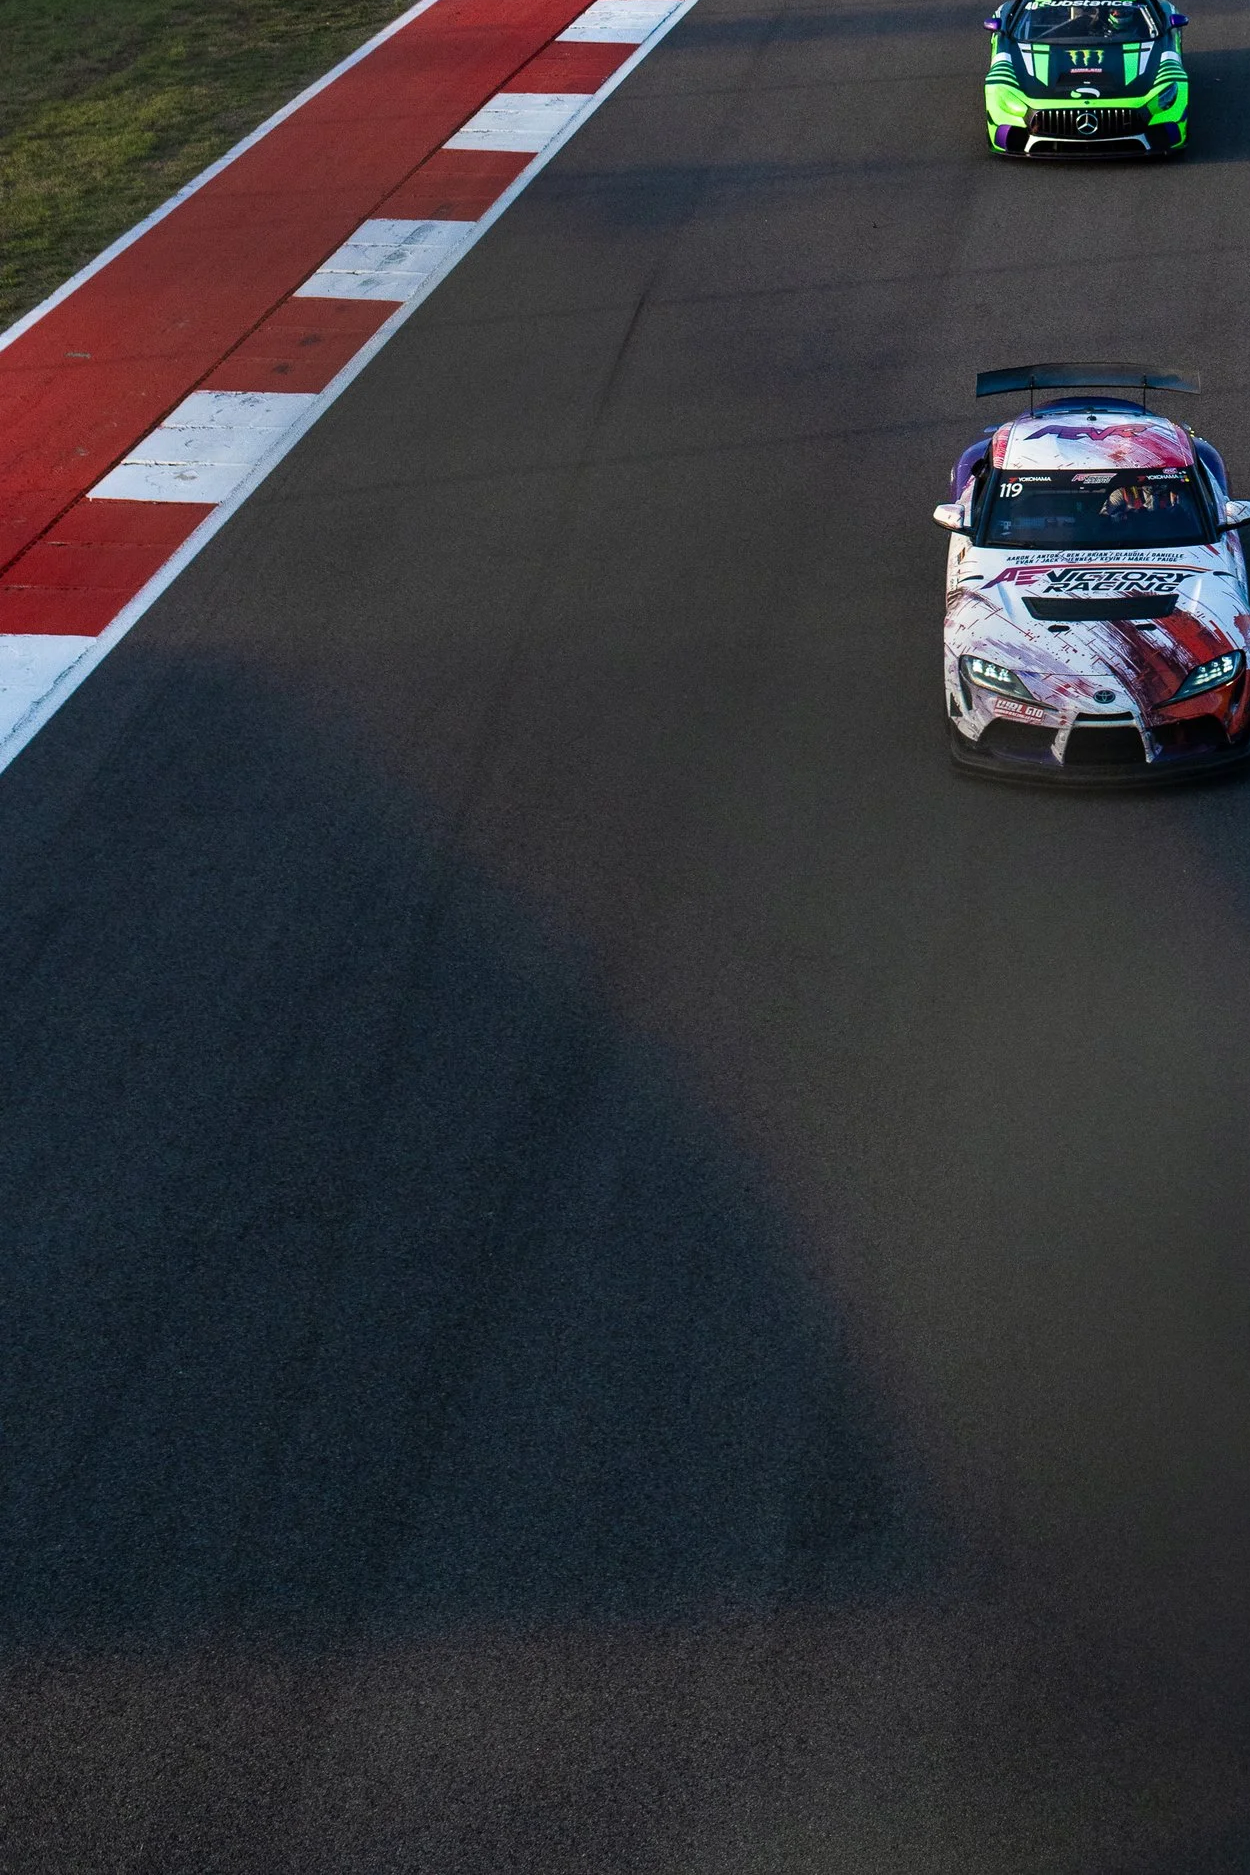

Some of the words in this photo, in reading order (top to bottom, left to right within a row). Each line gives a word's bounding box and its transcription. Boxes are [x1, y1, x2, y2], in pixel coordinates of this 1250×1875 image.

[1025, 1, 1039, 10] 40
[1000, 483, 1023, 498] 119
[1046, 568, 1196, 583] VICTORY
[1042, 582, 1180, 593] RACING
